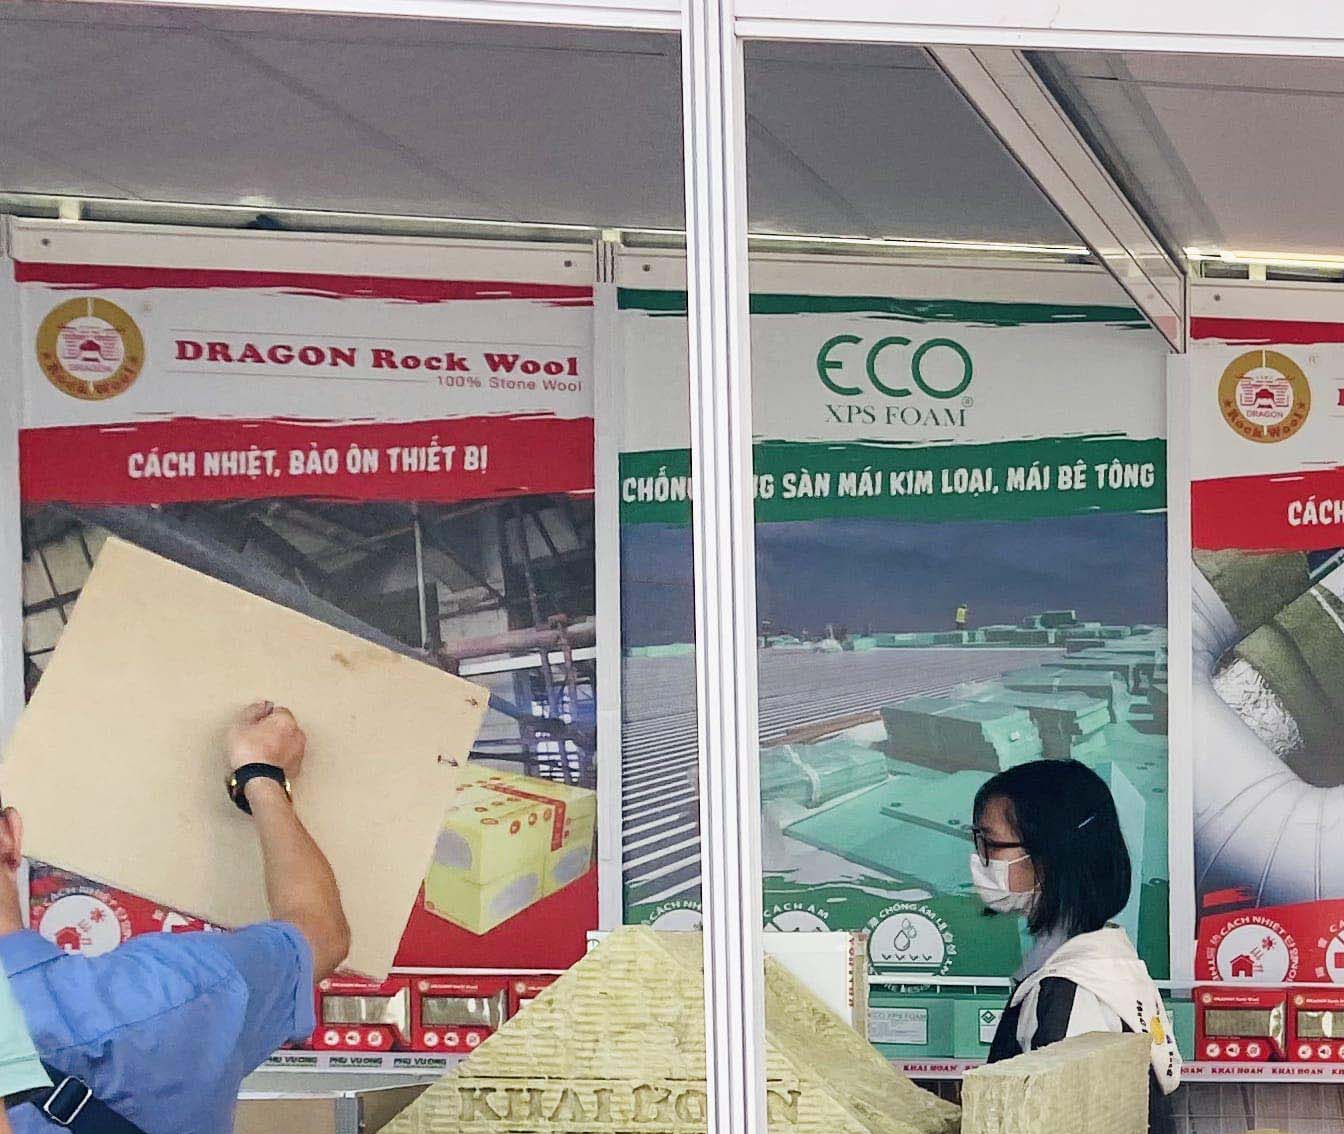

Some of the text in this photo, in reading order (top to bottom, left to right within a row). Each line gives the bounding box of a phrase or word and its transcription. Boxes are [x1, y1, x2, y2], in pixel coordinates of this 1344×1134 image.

[175, 339, 579, 376] DRAGON Rock Wool
[817, 335, 973, 399] ECO
[436, 375, 582, 392] 100% Stone Wool
[826, 404, 966, 427] XPS FOAM
[128, 435, 488, 479] CÁCH NHIỆT, BẢO ÔN THIẾT BỊ
[622, 465, 692, 502] CHỐN
[782, 467, 831, 499] SÀN
[838, 464, 882, 497] MÁI
[889, 470, 931, 497] KIM
[941, 467, 999, 498] LOẠI,
[1006, 458, 1050, 493] MÁI
[1057, 459, 1087, 490] BÊ
[1094, 457, 1155, 490] TÔNG
[632, 1083, 802, 1125] HON
